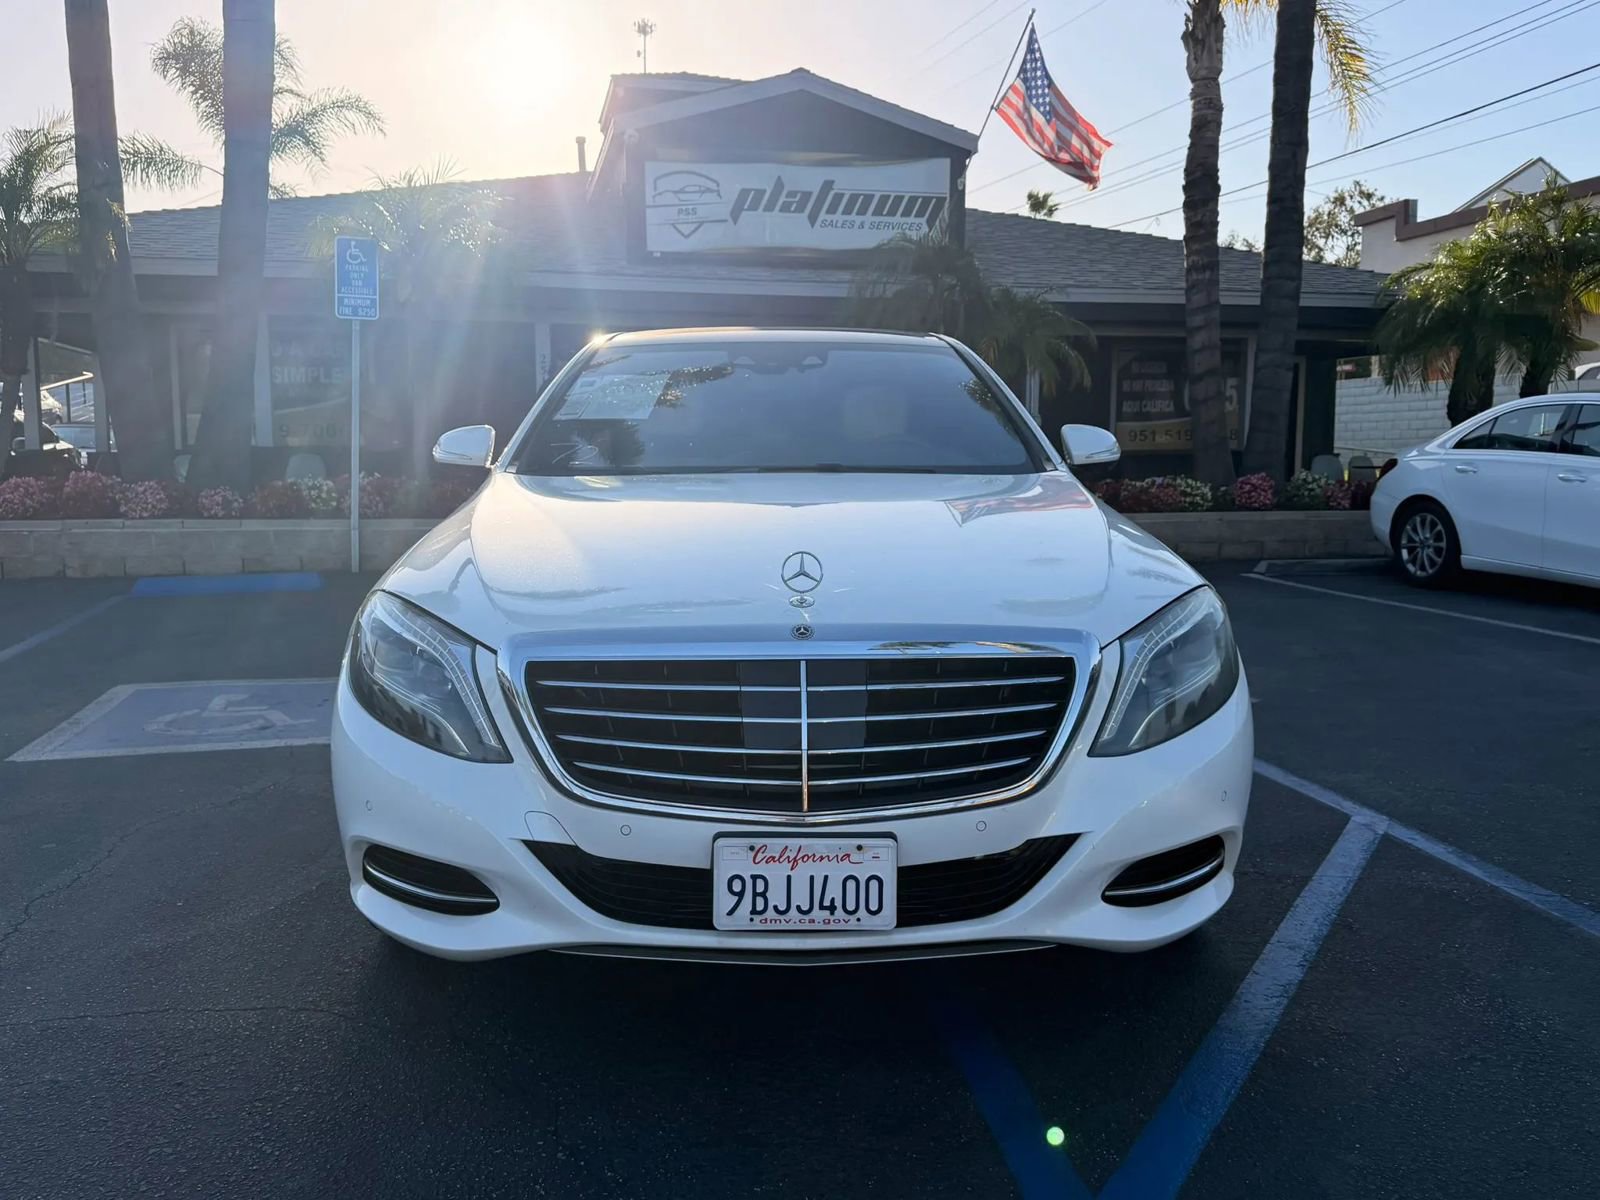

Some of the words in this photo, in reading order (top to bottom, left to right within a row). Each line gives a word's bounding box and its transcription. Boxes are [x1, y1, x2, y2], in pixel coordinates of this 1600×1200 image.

[730, 175, 949, 230] platinum
[677, 207, 698, 217] PSS
[820, 219, 856, 230] SALES
[857, 221, 866, 230] &
[868, 221, 923, 232] SERVICES
[343, 298, 371, 307] MINIMUM
[357, 307, 376, 316] $250
[271, 366, 344, 384] SIMPLE
[752, 844, 864, 871] California
[726, 873, 884, 916] 9BJJ400
[759, 917, 851, 925] dmv.ca.gov
